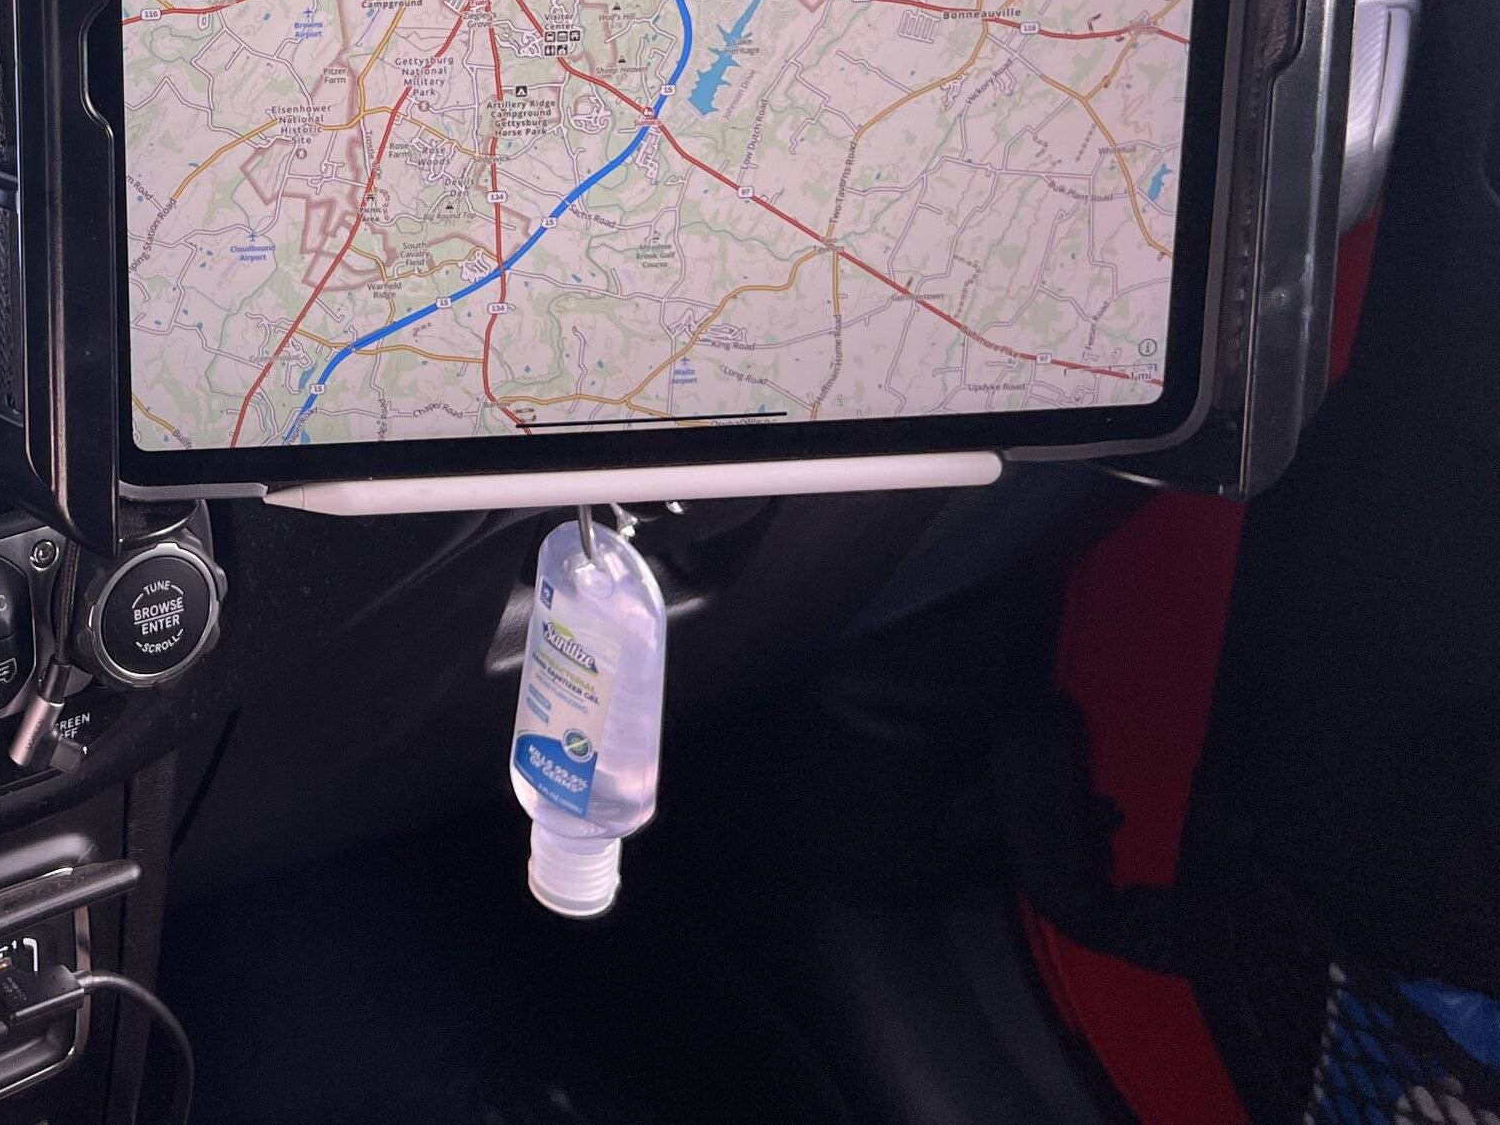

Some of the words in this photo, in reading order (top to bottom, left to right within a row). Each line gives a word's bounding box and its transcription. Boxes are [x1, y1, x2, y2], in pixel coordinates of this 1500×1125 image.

[943, 8, 1021, 20] Bonneauville
[295, 30, 322, 38] Airport
[395, 56, 453, 66] Gettysburg
[323, 68, 346, 76] Pitzer
[402, 66, 447, 75] National
[324, 76, 346, 84] Farm
[403, 78, 445, 86] Military
[413, 88, 435, 96] Park
[487, 101, 526, 109] Artillery
[530, 99, 556, 109] Ridge
[271, 105, 331, 114] Eisenhower
[491, 109, 551, 118] Campground
[495, 118, 548, 128] Gettysburg
[281, 126, 322, 134] Historic
[495, 128, 522, 136] Horse
[525, 127, 547, 136] Park
[291, 136, 312, 144] Site
[389, 142, 410, 150] Rose
[423, 146, 445, 154] Rose
[388, 150, 410, 158] Farm
[418, 157, 451, 166] Woods
[444, 178, 475, 186] Devils
[450, 188, 469, 197] Den
[230, 245, 275, 253] Cloudbound
[240, 254, 266, 262] Airport
[400, 250, 430, 259] Cavalry
[367, 282, 401, 290] Warfield
[373, 290, 396, 299] Ridge
[143, 579, 171, 597] TUNE
[133, 596, 185, 622] BROWSE
[140, 614, 181, 635] ENTER
[141, 636, 182, 655] SCROLL
